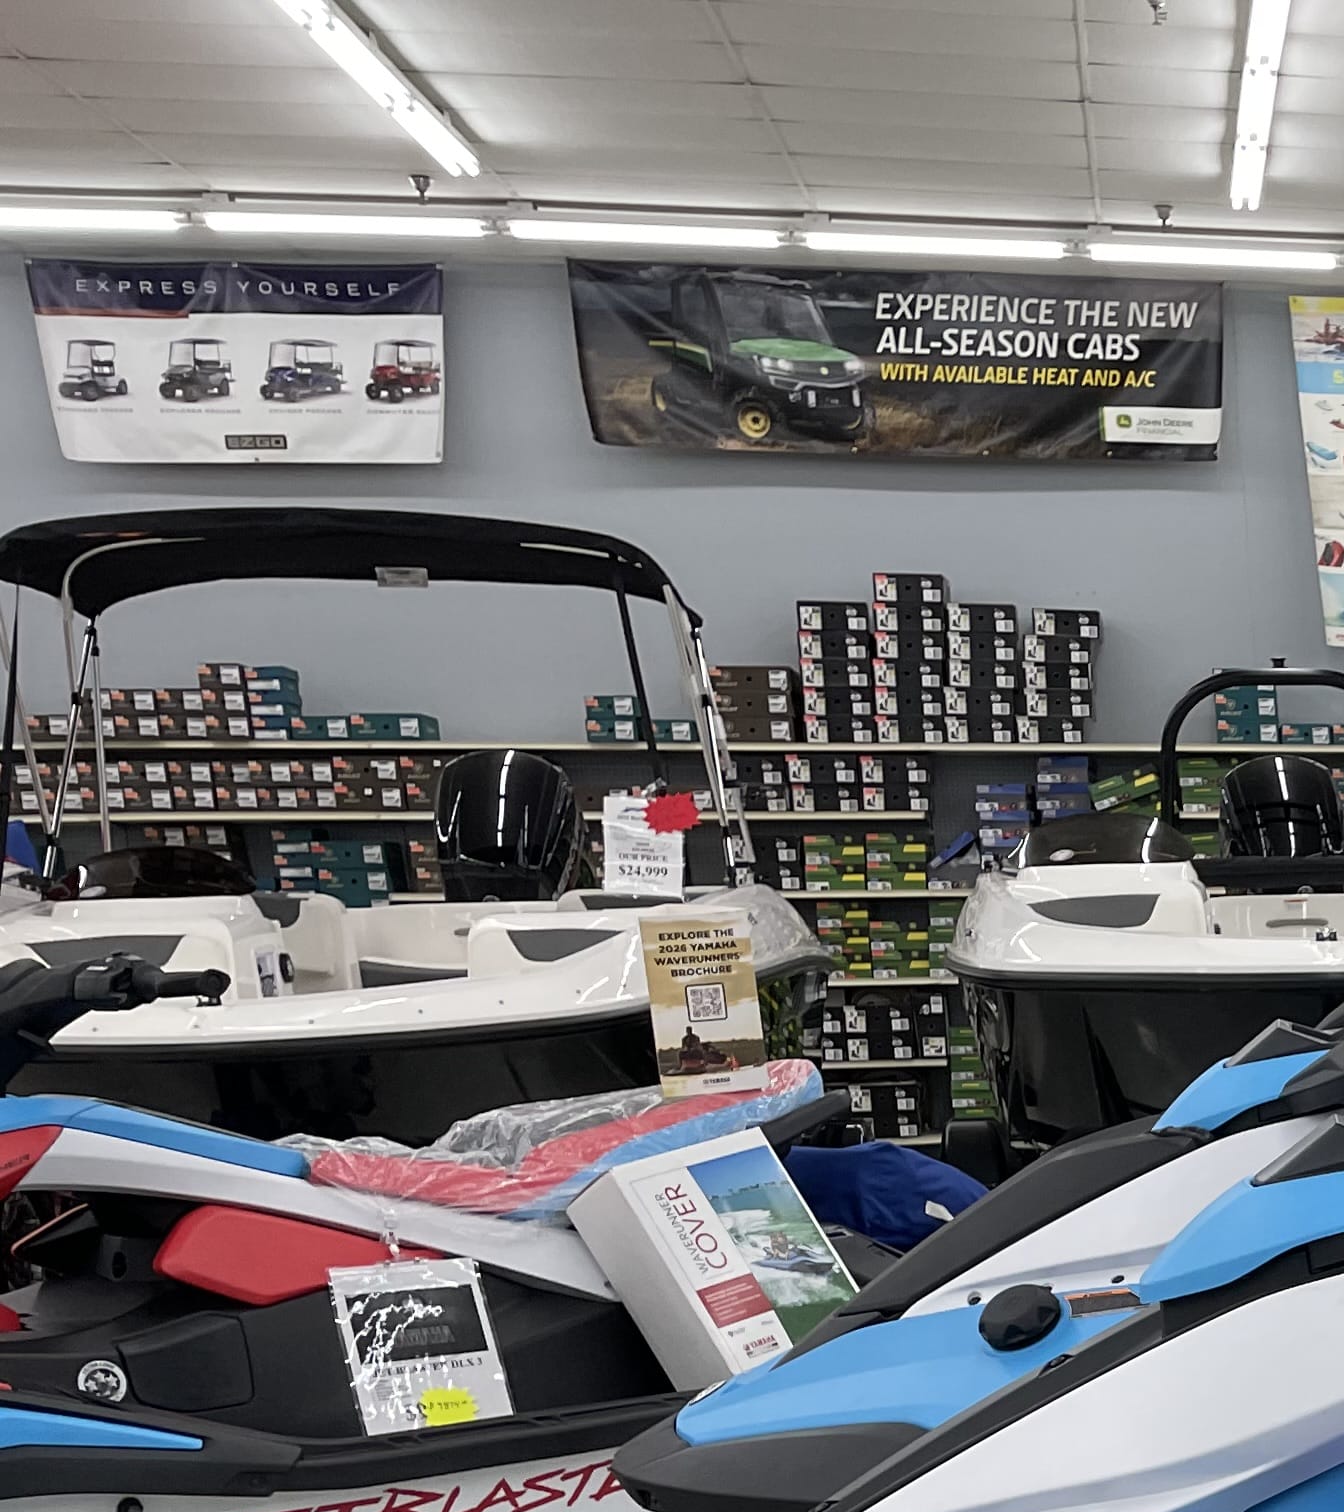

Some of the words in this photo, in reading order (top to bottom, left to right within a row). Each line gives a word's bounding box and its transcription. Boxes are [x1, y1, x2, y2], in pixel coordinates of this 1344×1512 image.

[75, 277, 219, 297] EXPRESS
[237, 279, 403, 299] YOURSELF
[875, 292, 1055, 326] EXPERIENCE
[1065, 299, 1122, 328] THE
[1127, 300, 1198, 330] NEW
[876, 327, 1061, 360] ALL-SEASON
[1066, 333, 1141, 361] CABS
[880, 362, 928, 383] WITH
[932, 364, 1028, 386] AVAILABLE
[1032, 367, 1078, 387] HEAT
[1081, 368, 1122, 388] AND
[1124, 369, 1158, 389] A/C
[1136, 417, 1162, 427] JOHN
[1163, 418, 1194, 429] DEERE
[618, 864, 668, 878] $24,999
[658, 931, 711, 941] EXPLORE
[713, 928, 734, 937] THE
[690, 940, 737, 952] YAMAHA
[670, 965, 732, 977] BROCHURE
[654, 1192, 709, 1275] WAVERUNNER
[664, 1183, 728, 1270] COVER
